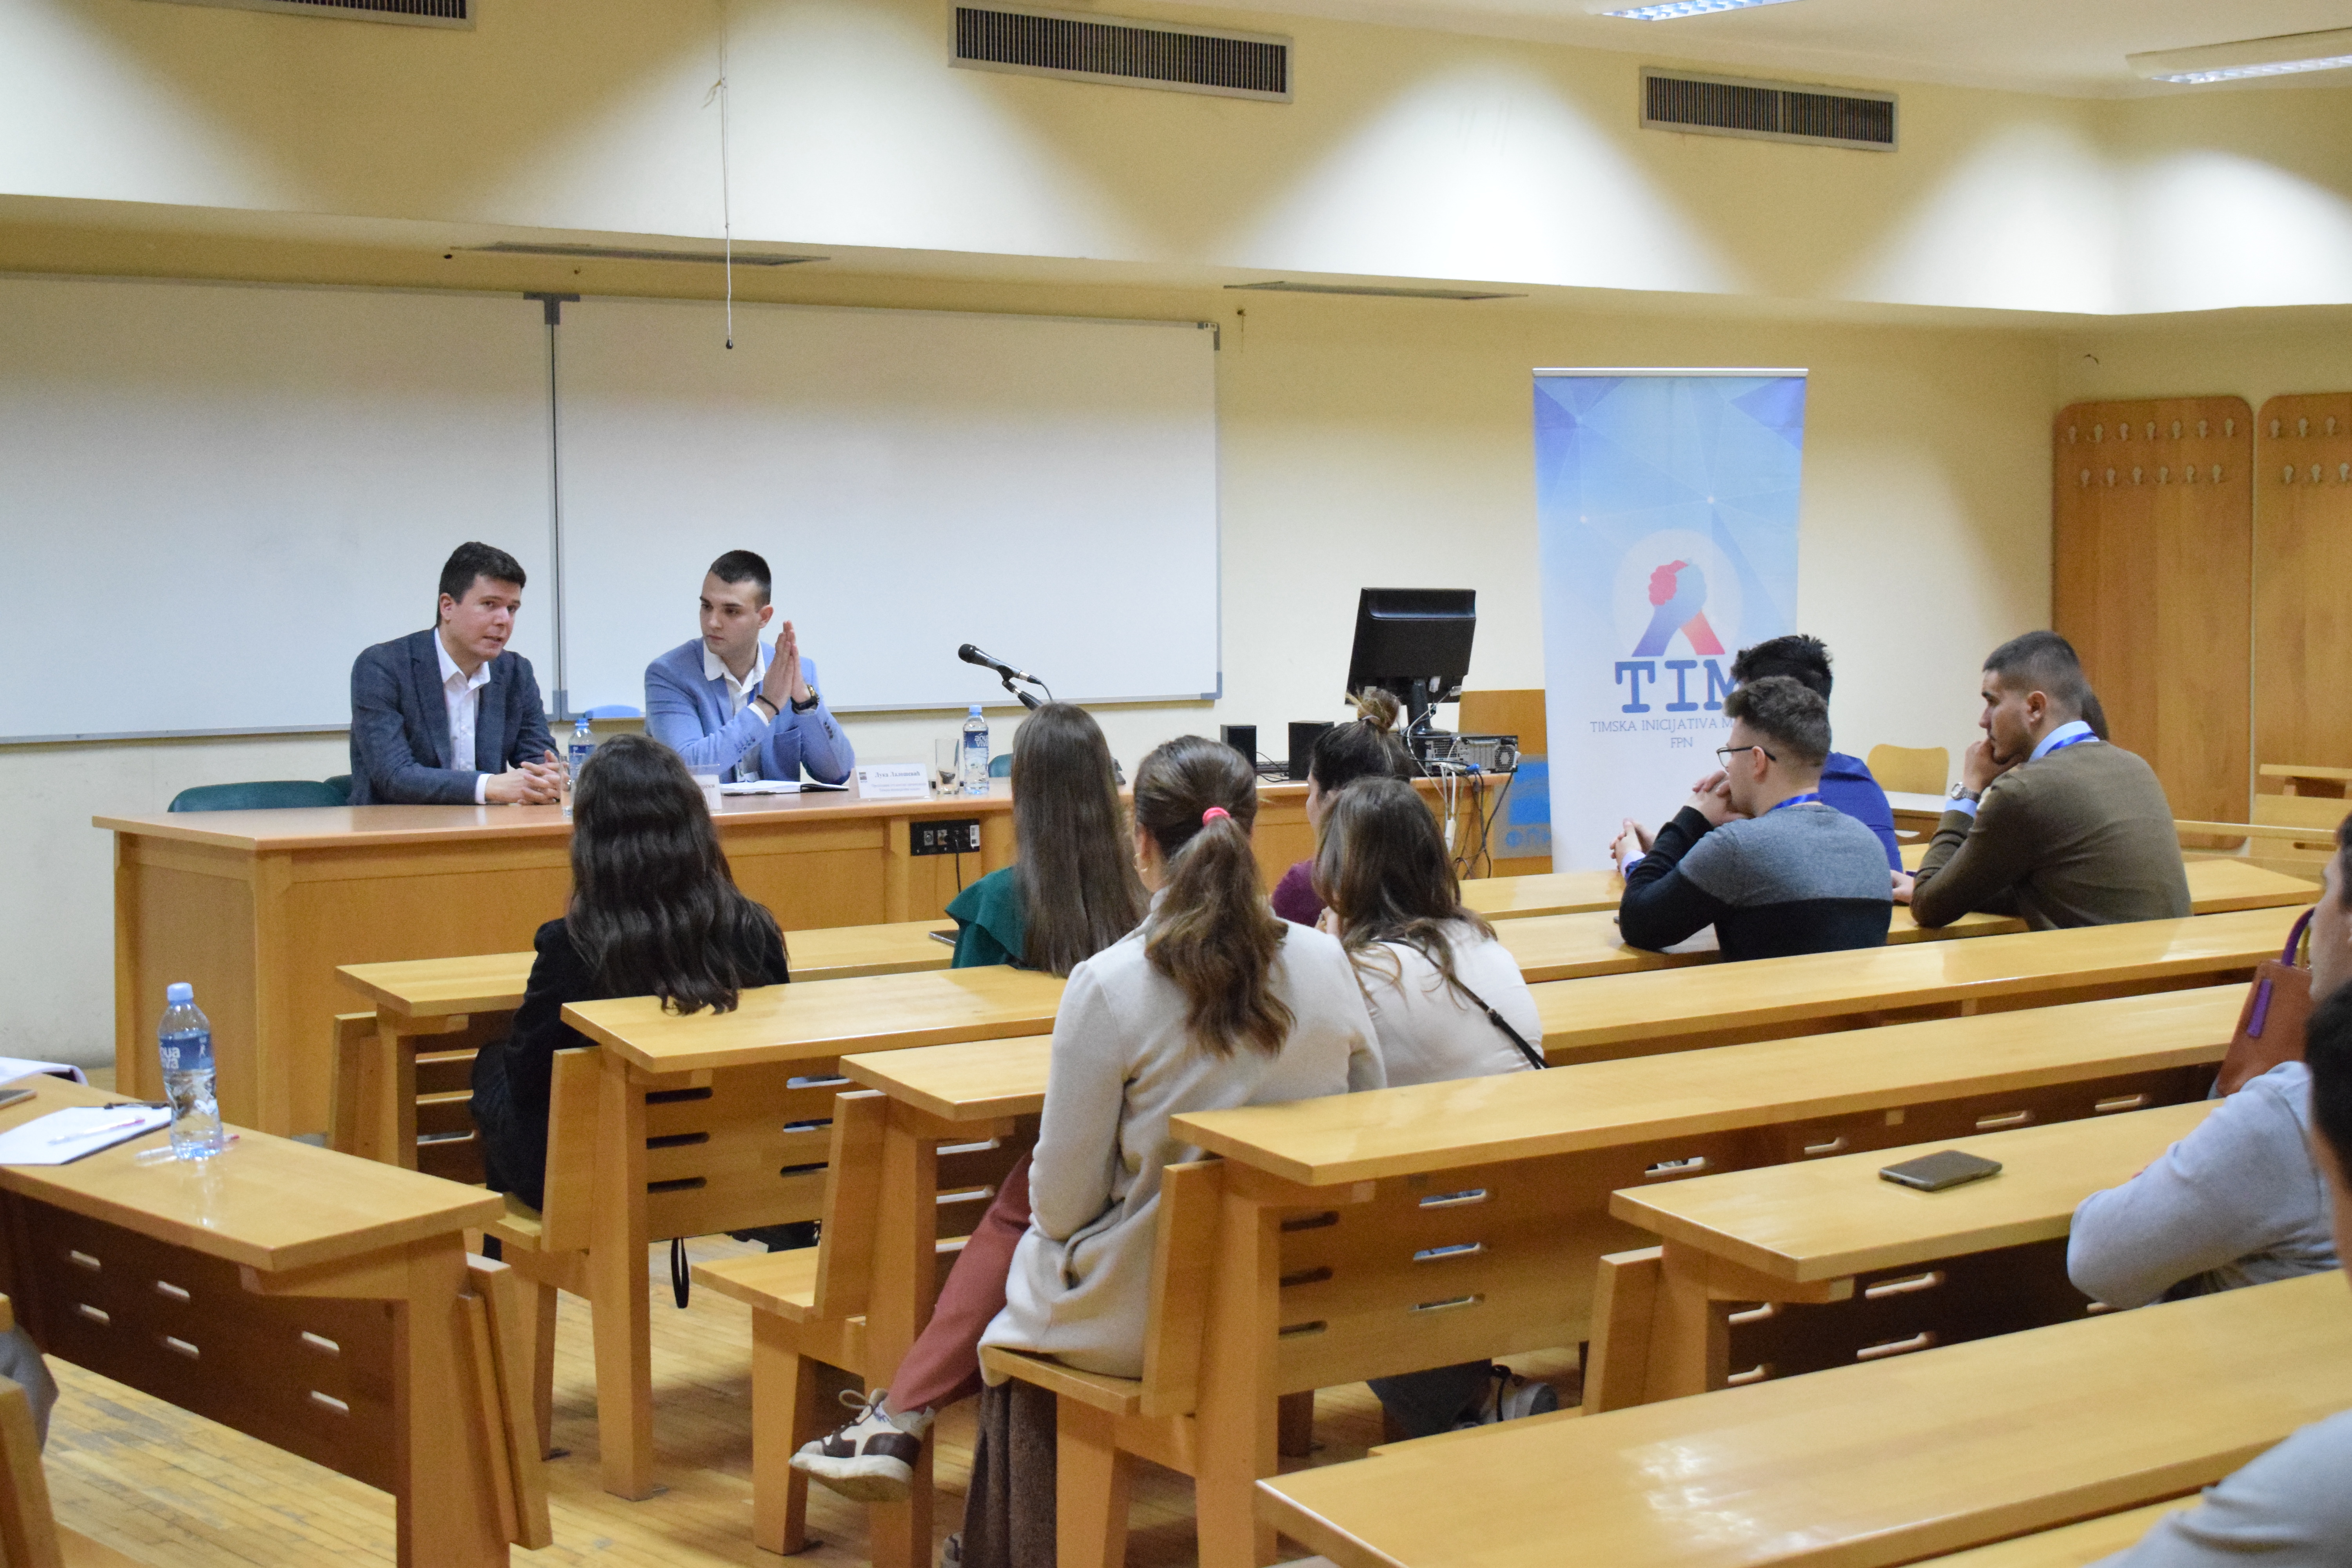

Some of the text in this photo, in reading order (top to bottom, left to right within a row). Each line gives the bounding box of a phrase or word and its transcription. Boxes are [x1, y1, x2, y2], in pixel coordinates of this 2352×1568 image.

[1615, 659, 1737, 713] TIM
[1590, 721, 1637, 732] TIMSKA
[1642, 718, 1717, 733] INICIJATIVA
[1670, 737, 1693, 748] FPN
